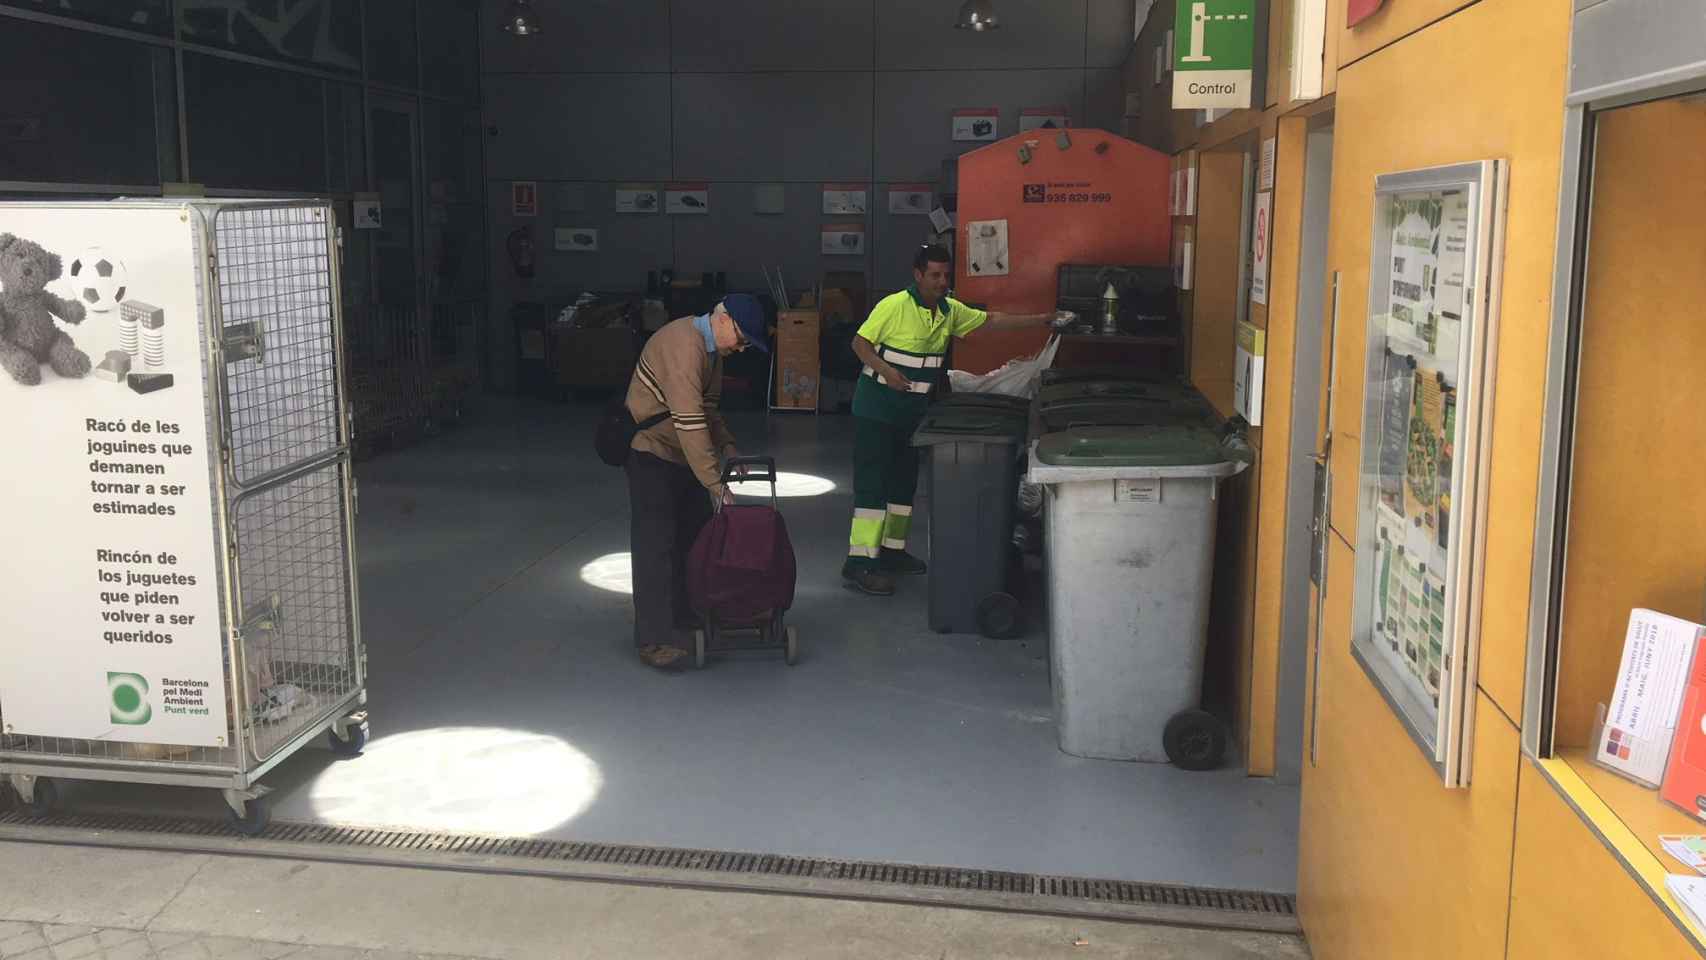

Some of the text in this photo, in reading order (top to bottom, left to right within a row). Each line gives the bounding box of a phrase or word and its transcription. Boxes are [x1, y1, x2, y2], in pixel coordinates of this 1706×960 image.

[1188, 83, 1236, 95] Control
[86, 418, 180, 434] Racó de les
[87, 439, 193, 457] joguines que
[89, 460, 165, 475] demanen
[91, 480, 186, 496] tornar a ser
[92, 501, 176, 516] estimades
[96, 549, 177, 565] Rincón de
[98, 569, 196, 587] los juguetes
[100, 591, 179, 606] que piden
[101, 610, 195, 625] volver a ser
[103, 630, 173, 645] queridos
[162, 678, 209, 687] Barcelona
[163, 688, 202, 696] pel Medi
[164, 696, 204, 705] Ambient
[164, 705, 208, 715] Punt verd
